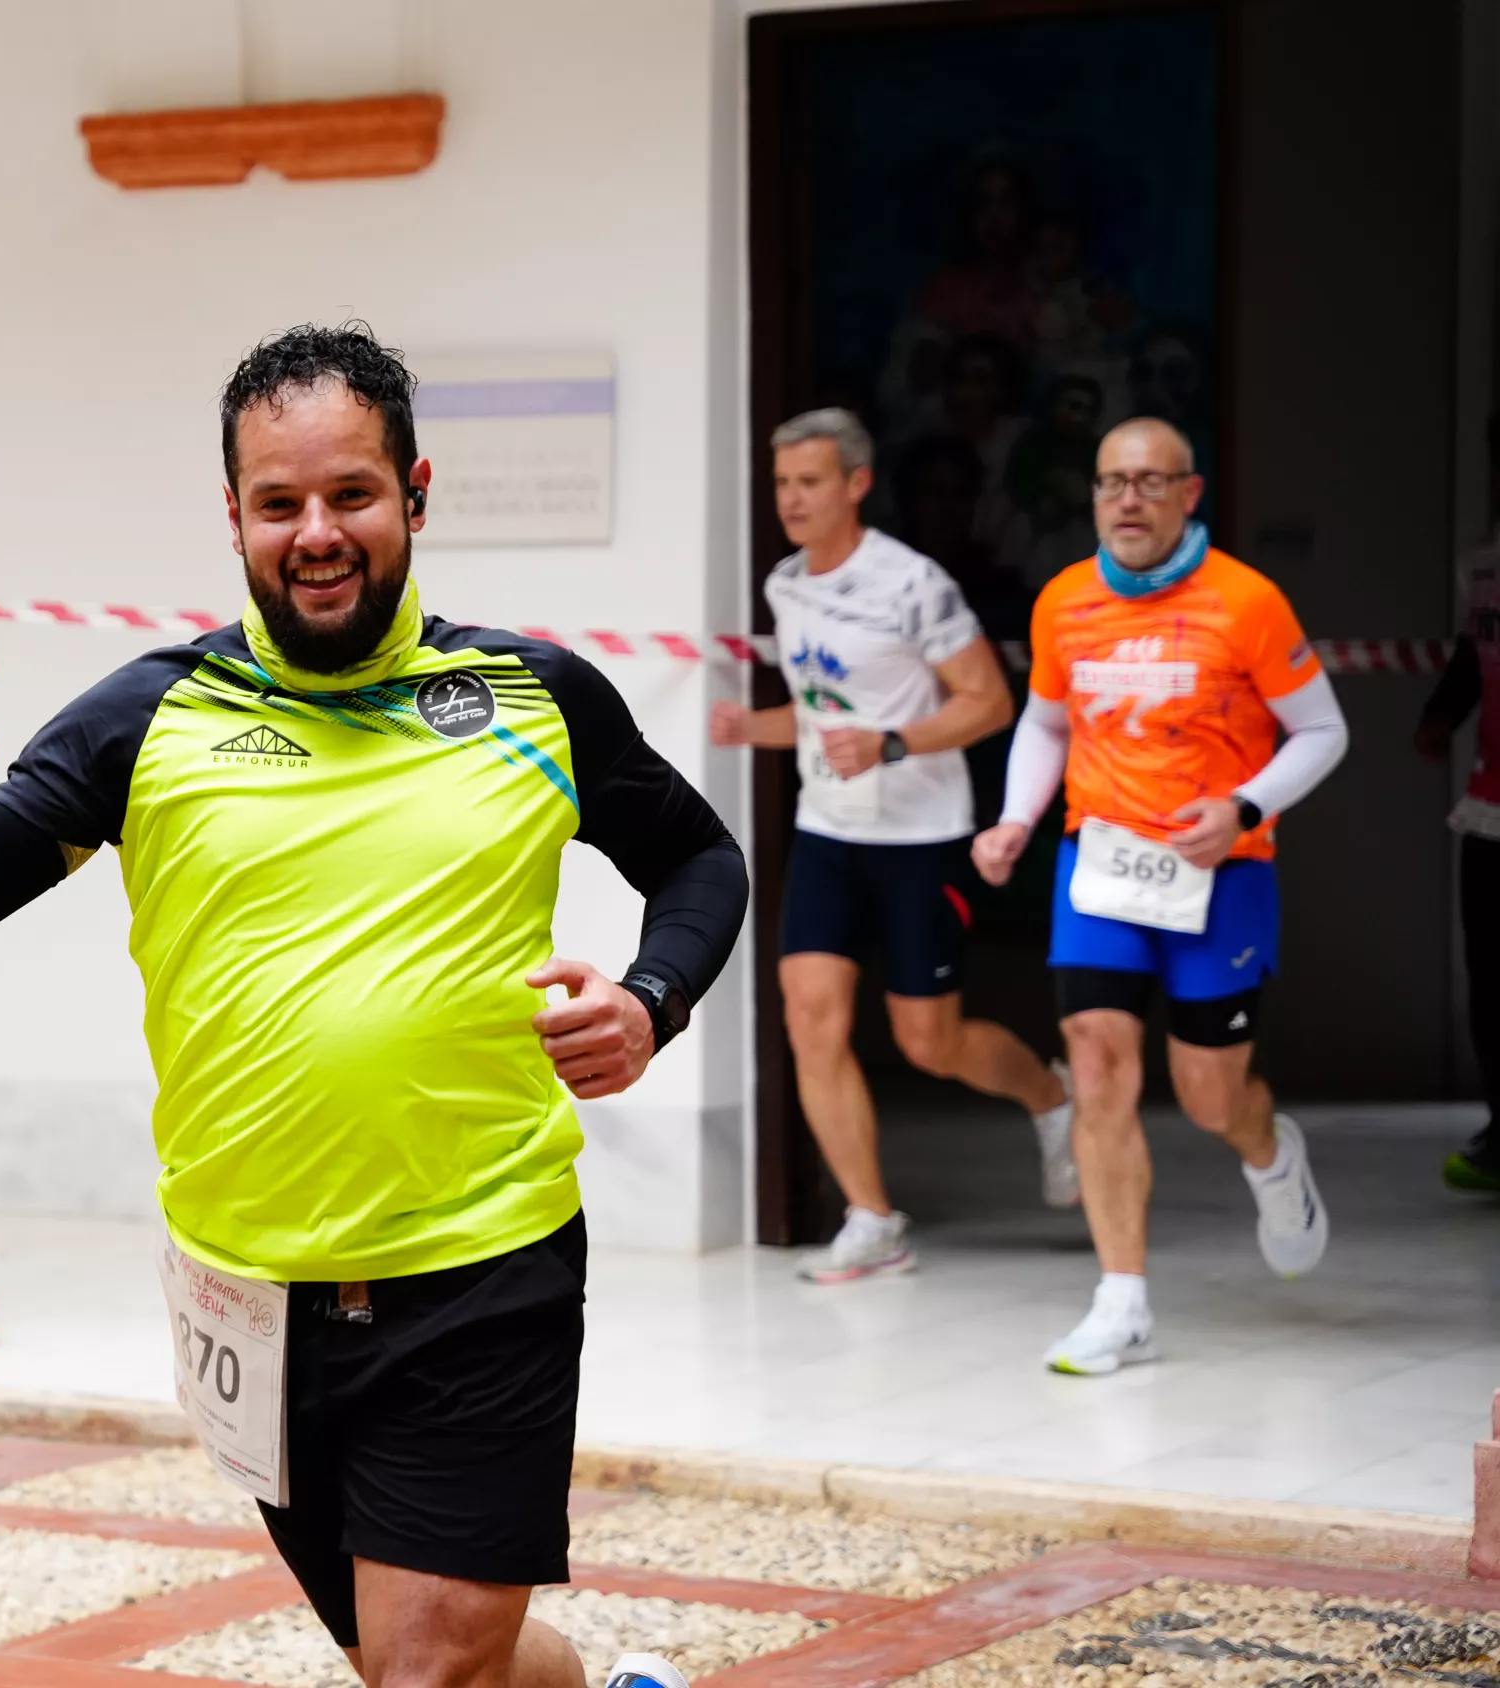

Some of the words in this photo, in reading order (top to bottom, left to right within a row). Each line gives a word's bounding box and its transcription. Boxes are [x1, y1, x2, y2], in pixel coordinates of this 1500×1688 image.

[213, 754, 309, 768] ESMONSUR
[1110, 846, 1178, 888] 569
[178, 1311, 240, 1404] 870
